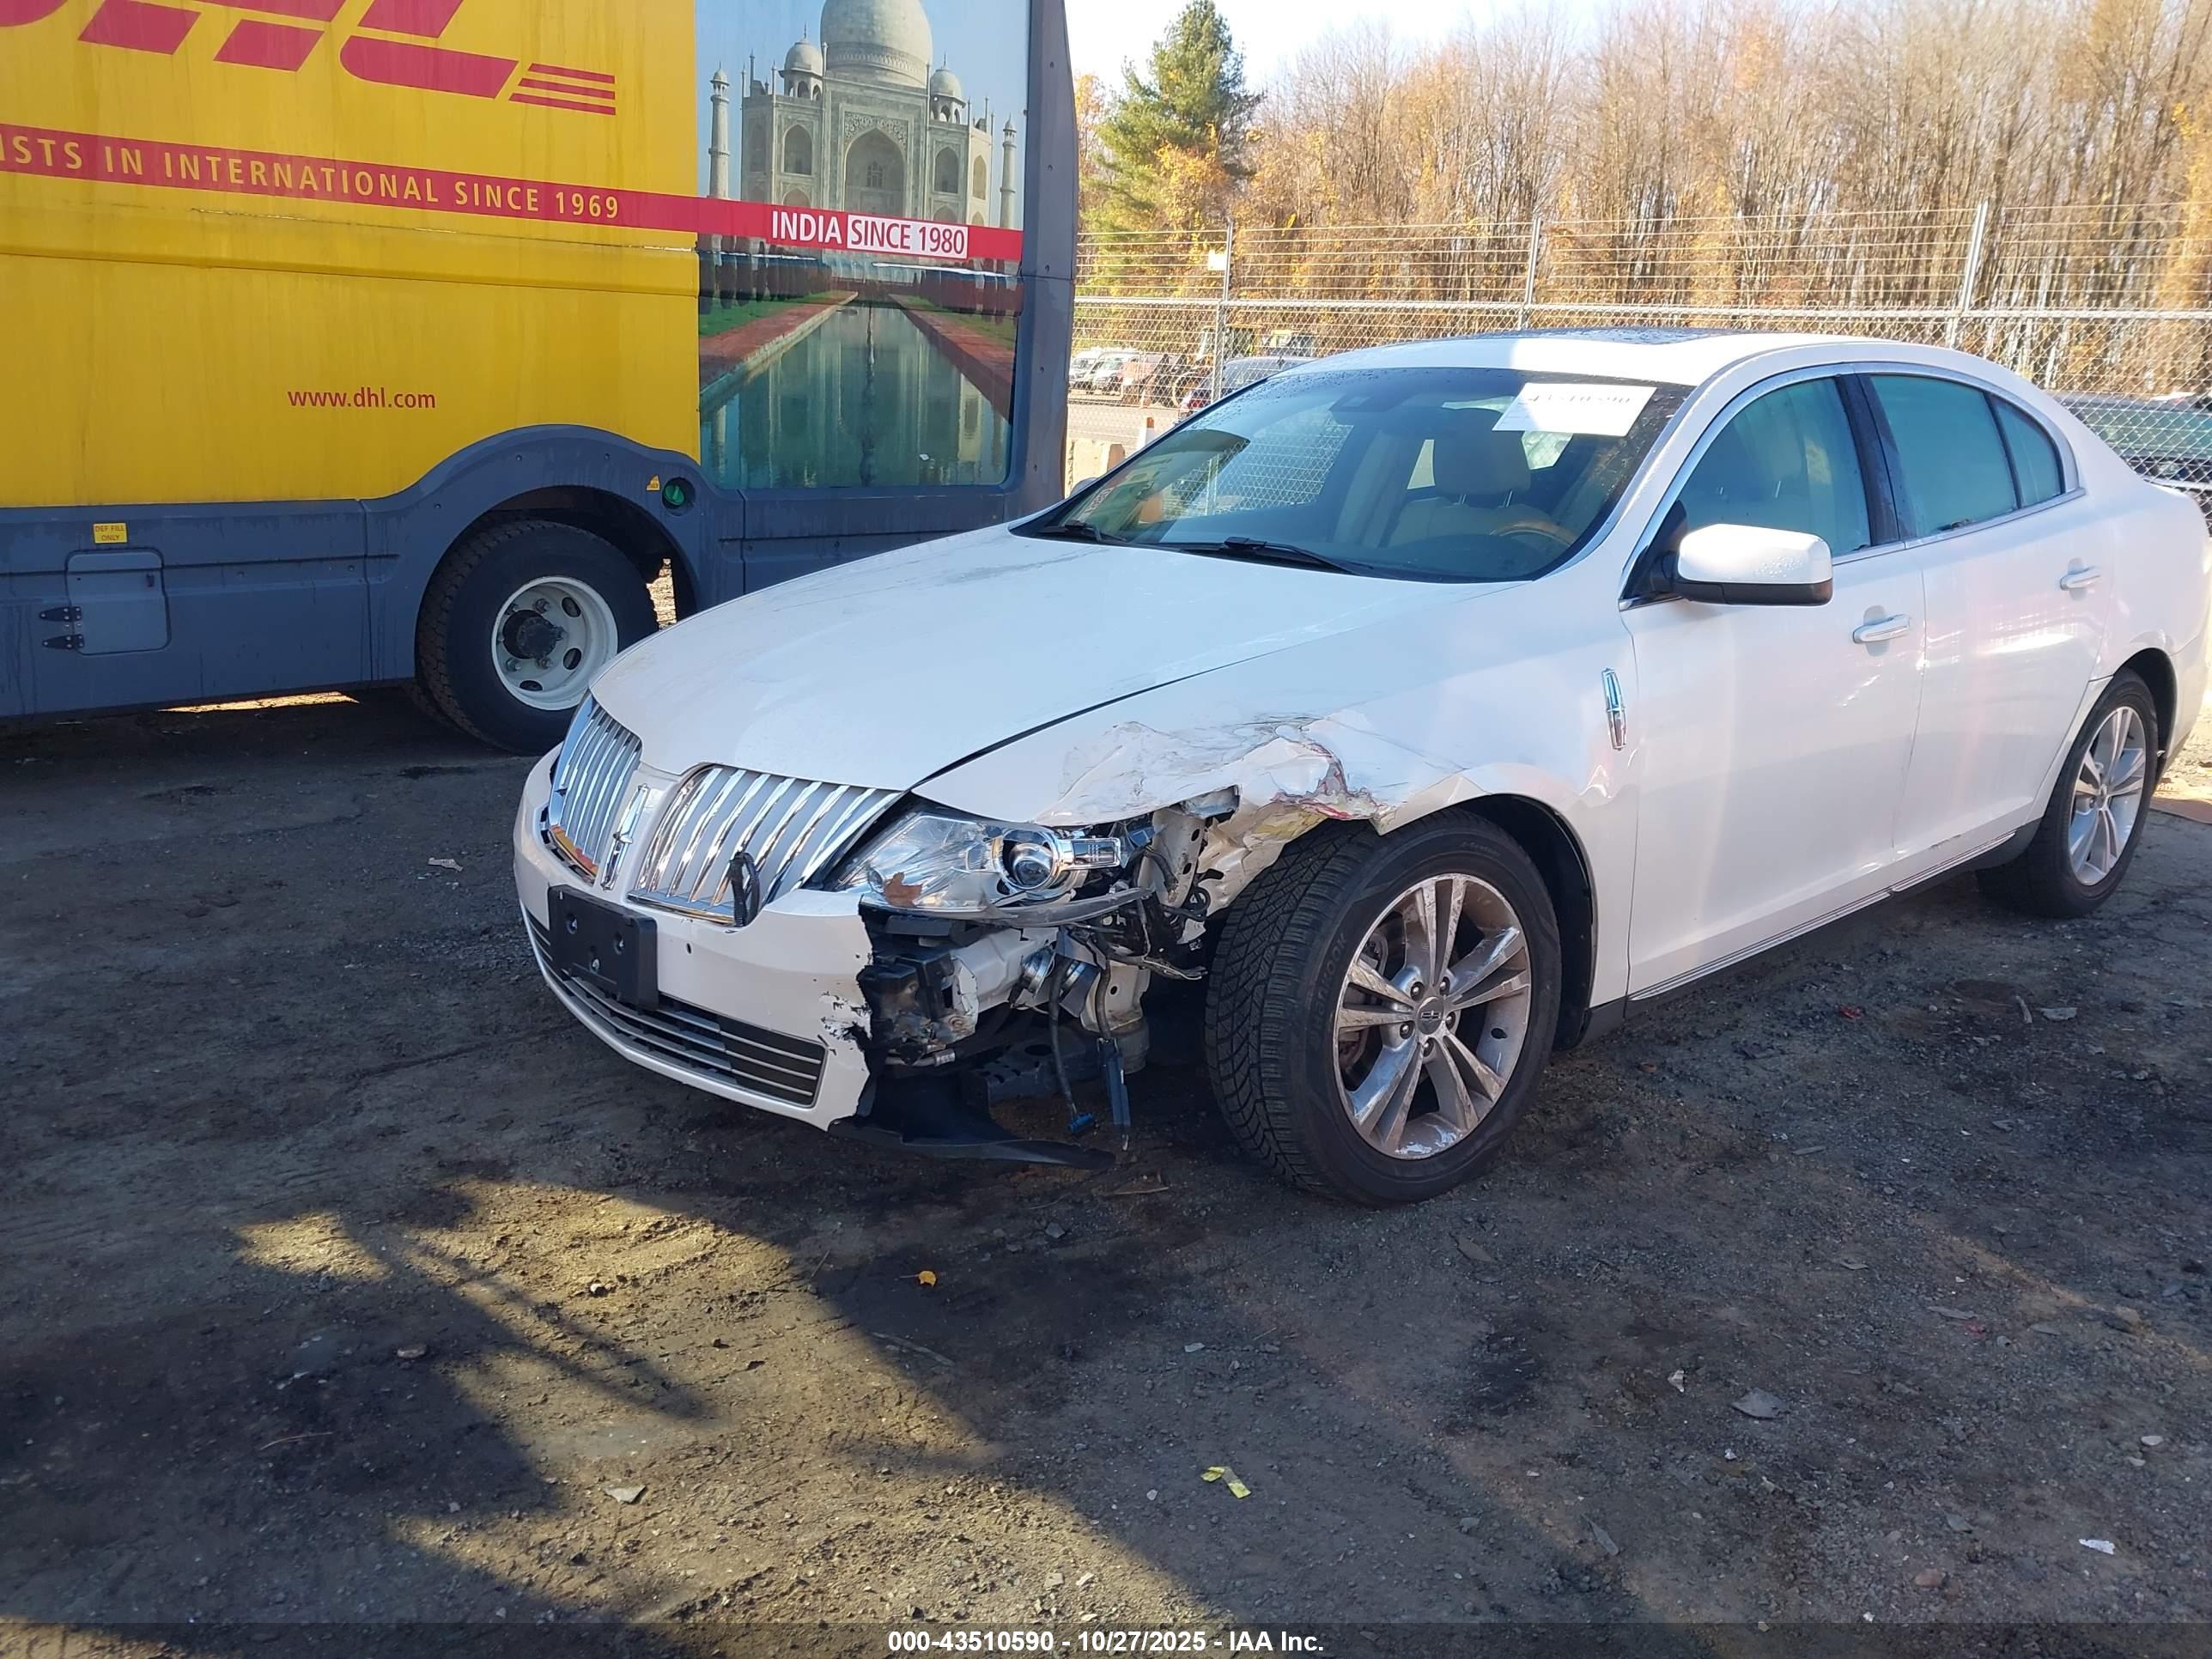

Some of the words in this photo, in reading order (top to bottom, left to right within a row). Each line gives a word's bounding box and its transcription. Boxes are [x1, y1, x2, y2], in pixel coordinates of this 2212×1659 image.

[105, 147, 143, 176] IN
[164, 152, 439, 204] INTERNATIONAL
[454, 180, 539, 212] SINCE
[556, 191, 619, 219] 1969
[773, 210, 842, 245] INDIA
[851, 219, 911, 250] SINCE
[918, 225, 965, 255] 1980
[287, 386, 436, 409] www.dhl.com
